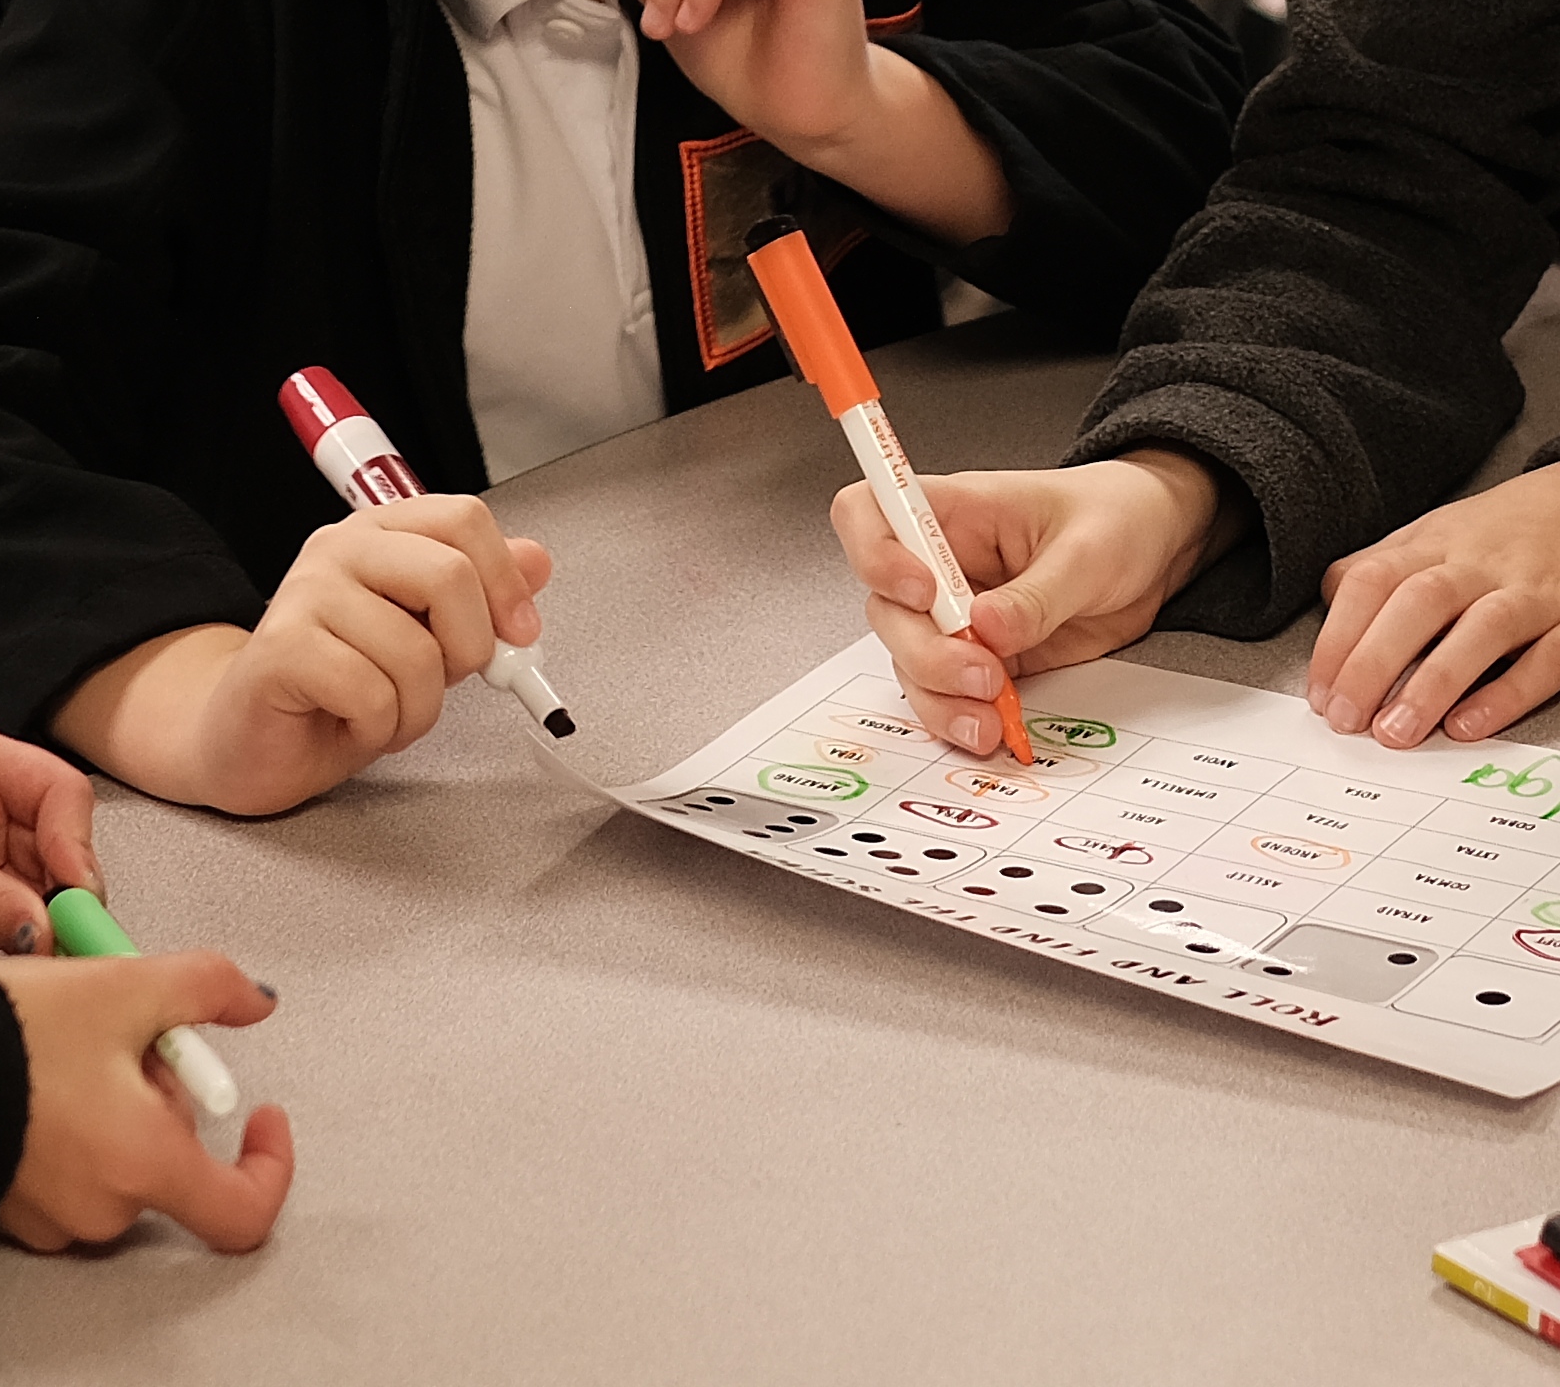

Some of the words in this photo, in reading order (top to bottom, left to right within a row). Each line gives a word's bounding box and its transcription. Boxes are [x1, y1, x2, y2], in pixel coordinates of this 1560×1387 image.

[869, 416, 894, 459] Erase
[923, 517, 942, 539] Art
[937, 541, 966, 589] Shuttle
[858, 718, 914, 738] ACROSS
[1192, 753, 1239, 770] AVOID
[773, 772, 842, 793] AMAZING
[971, 778, 1020, 796] PANDA
[1140, 776, 1218, 800] UMBRELLA
[1343, 786, 1383, 802] SOFA
[1118, 809, 1167, 825] AGREE
[1305, 812, 1350, 831] PIZZA
[1260, 839, 1322, 862] AROUND
[1225, 871, 1283, 890] ASLEEP
[1414, 872, 1471, 893] COMMA
[1376, 905, 1433, 925] AFRAID
[1108, 957, 1207, 987] AND
[1223, 985, 1340, 1028] ROLL
